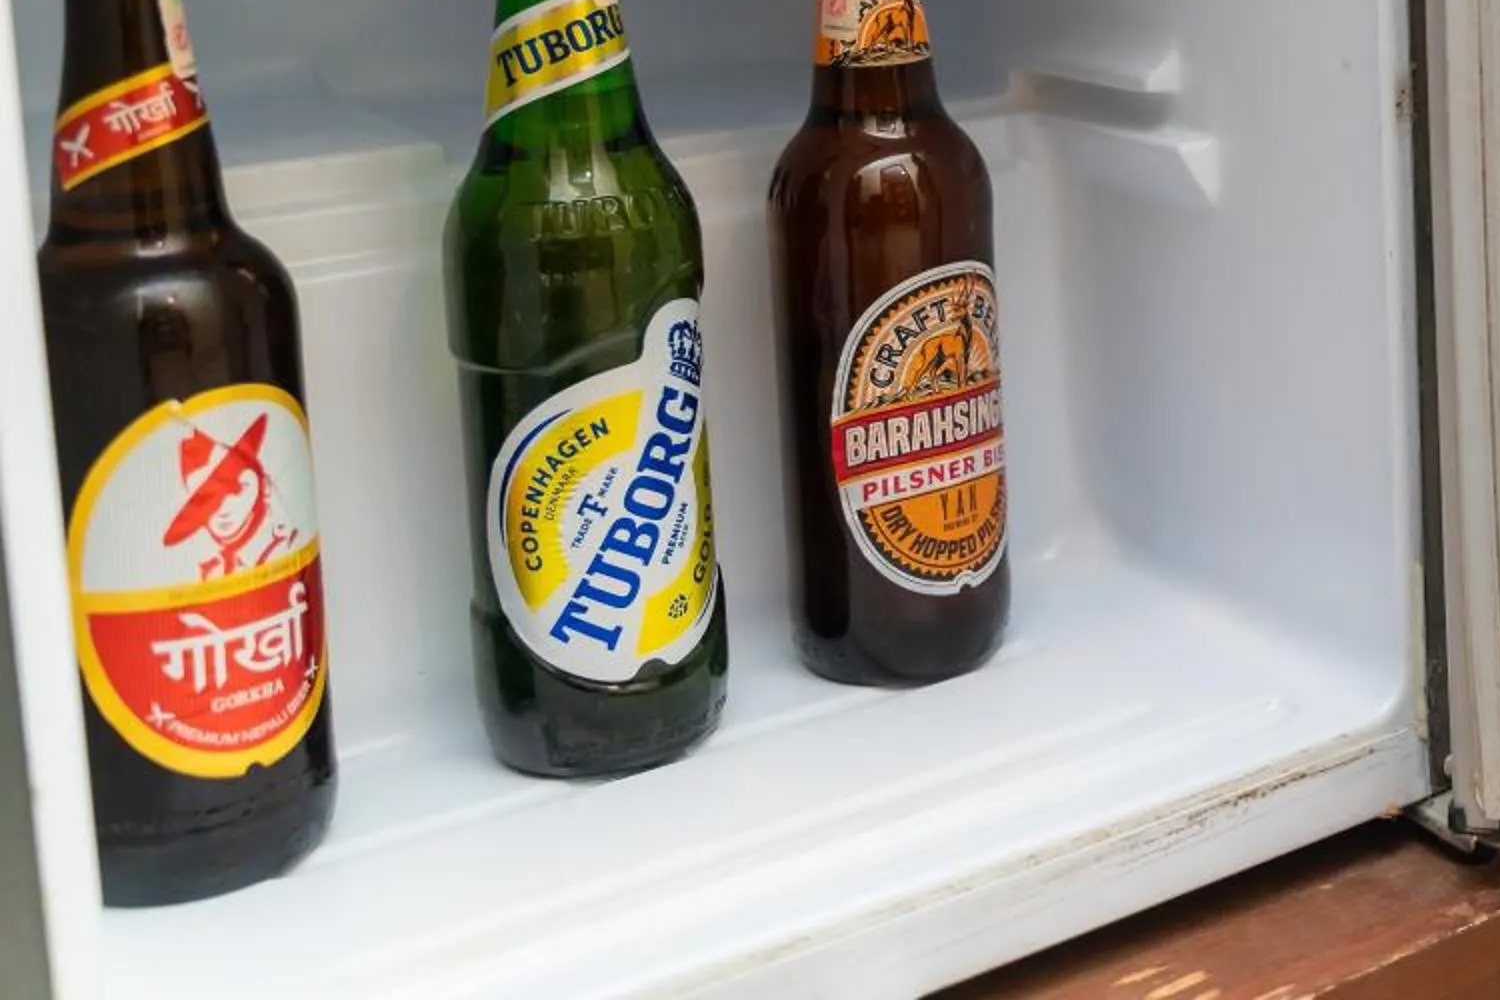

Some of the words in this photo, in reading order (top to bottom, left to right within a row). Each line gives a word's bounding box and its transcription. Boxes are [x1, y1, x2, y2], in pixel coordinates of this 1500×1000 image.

[496, 4, 624, 87] TUBORG
[869, 297, 948, 389] CRAFT
[845, 389, 1002, 467] BARAHSING
[517, 416, 610, 572] COPENHAGEN
[549, 385, 700, 652] TUBORG
[571, 517, 593, 549] TRADE
[597, 466, 618, 497] MARK
[862, 453, 976, 503] PILSNER
[661, 502, 689, 566] PREMIUM
[882, 503, 917, 544] DRY
[908, 533, 977, 561] HOPPED
[151, 581, 307, 694] गोर्खा
